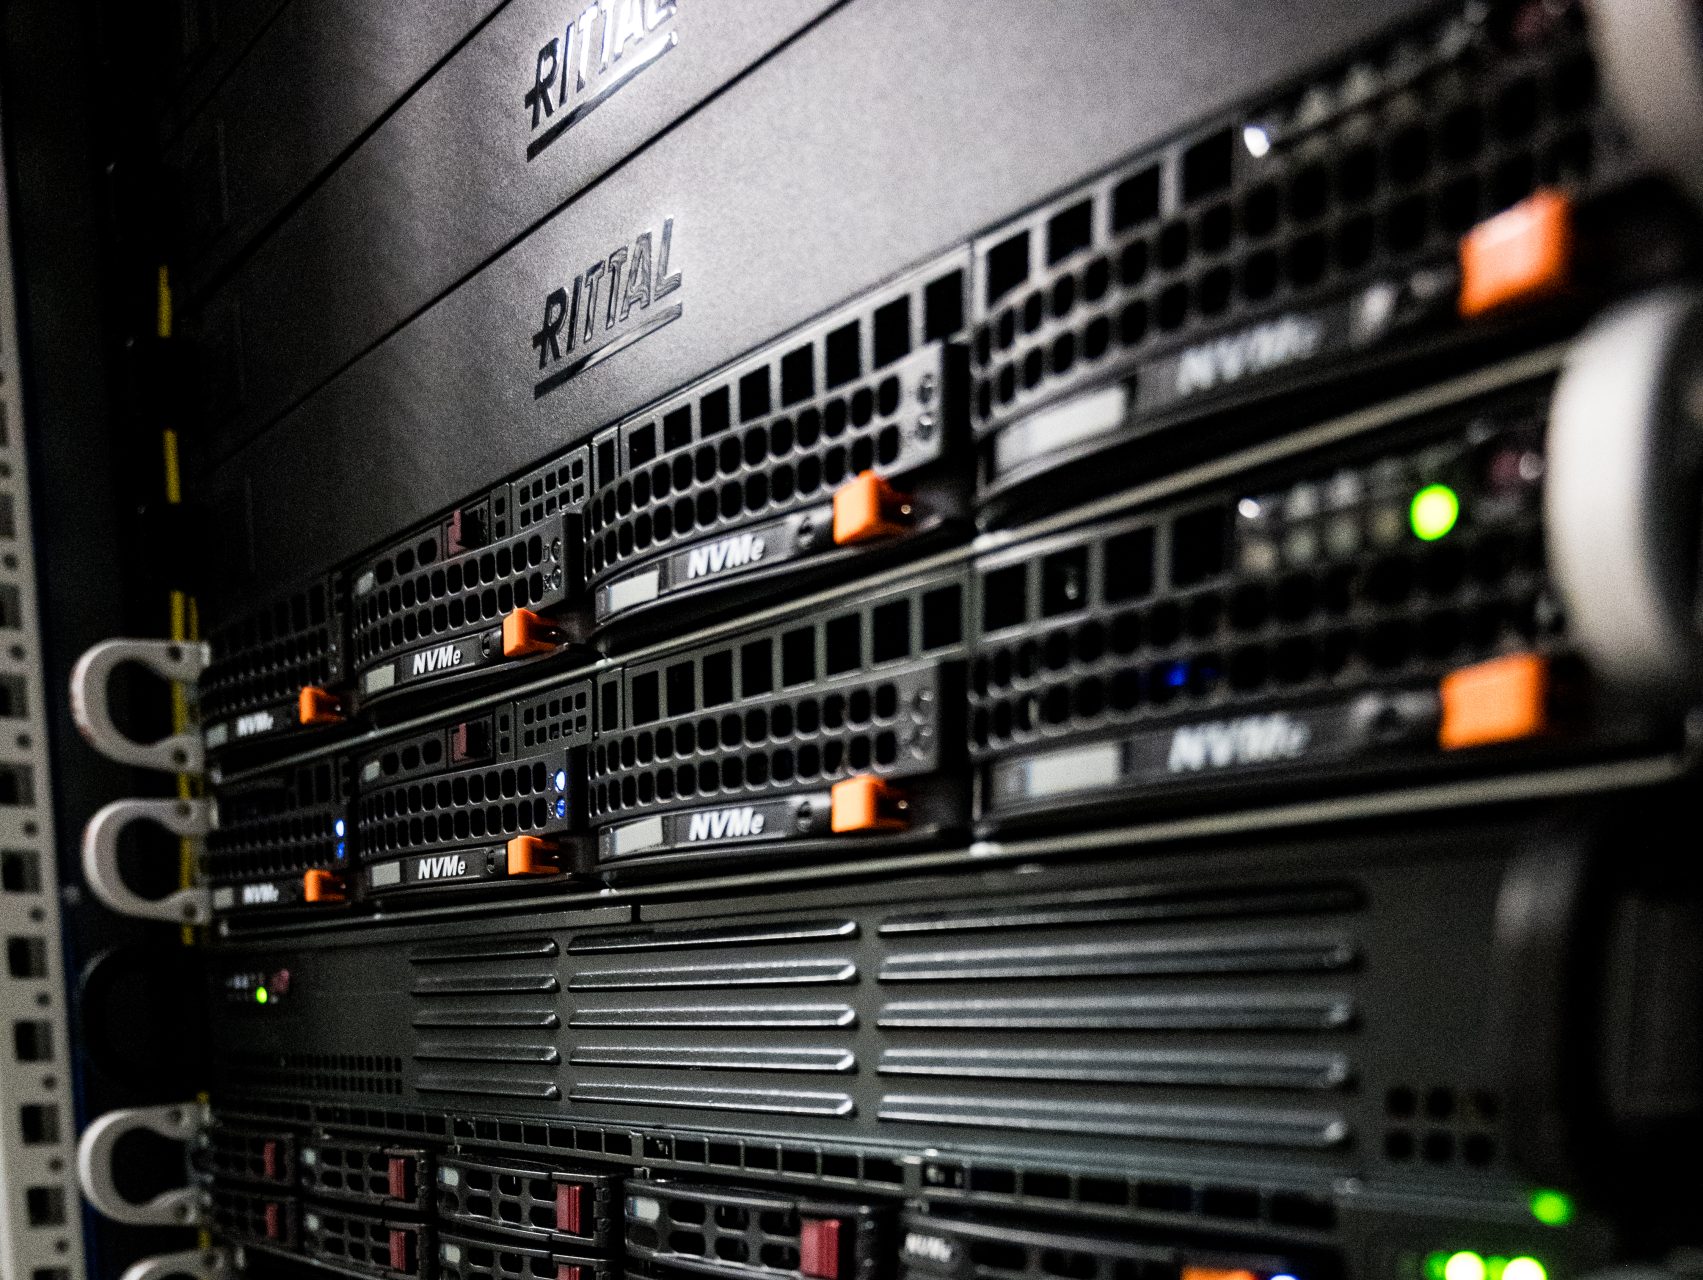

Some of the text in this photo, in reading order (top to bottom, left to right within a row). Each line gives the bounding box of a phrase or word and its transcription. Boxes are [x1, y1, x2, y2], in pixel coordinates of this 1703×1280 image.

[532, 215, 682, 370] RITTAL
[688, 533, 765, 579] NVMe
[412, 644, 461, 675] NVMe
[688, 806, 765, 842] NVMe
[417, 855, 466, 880] NVMe
